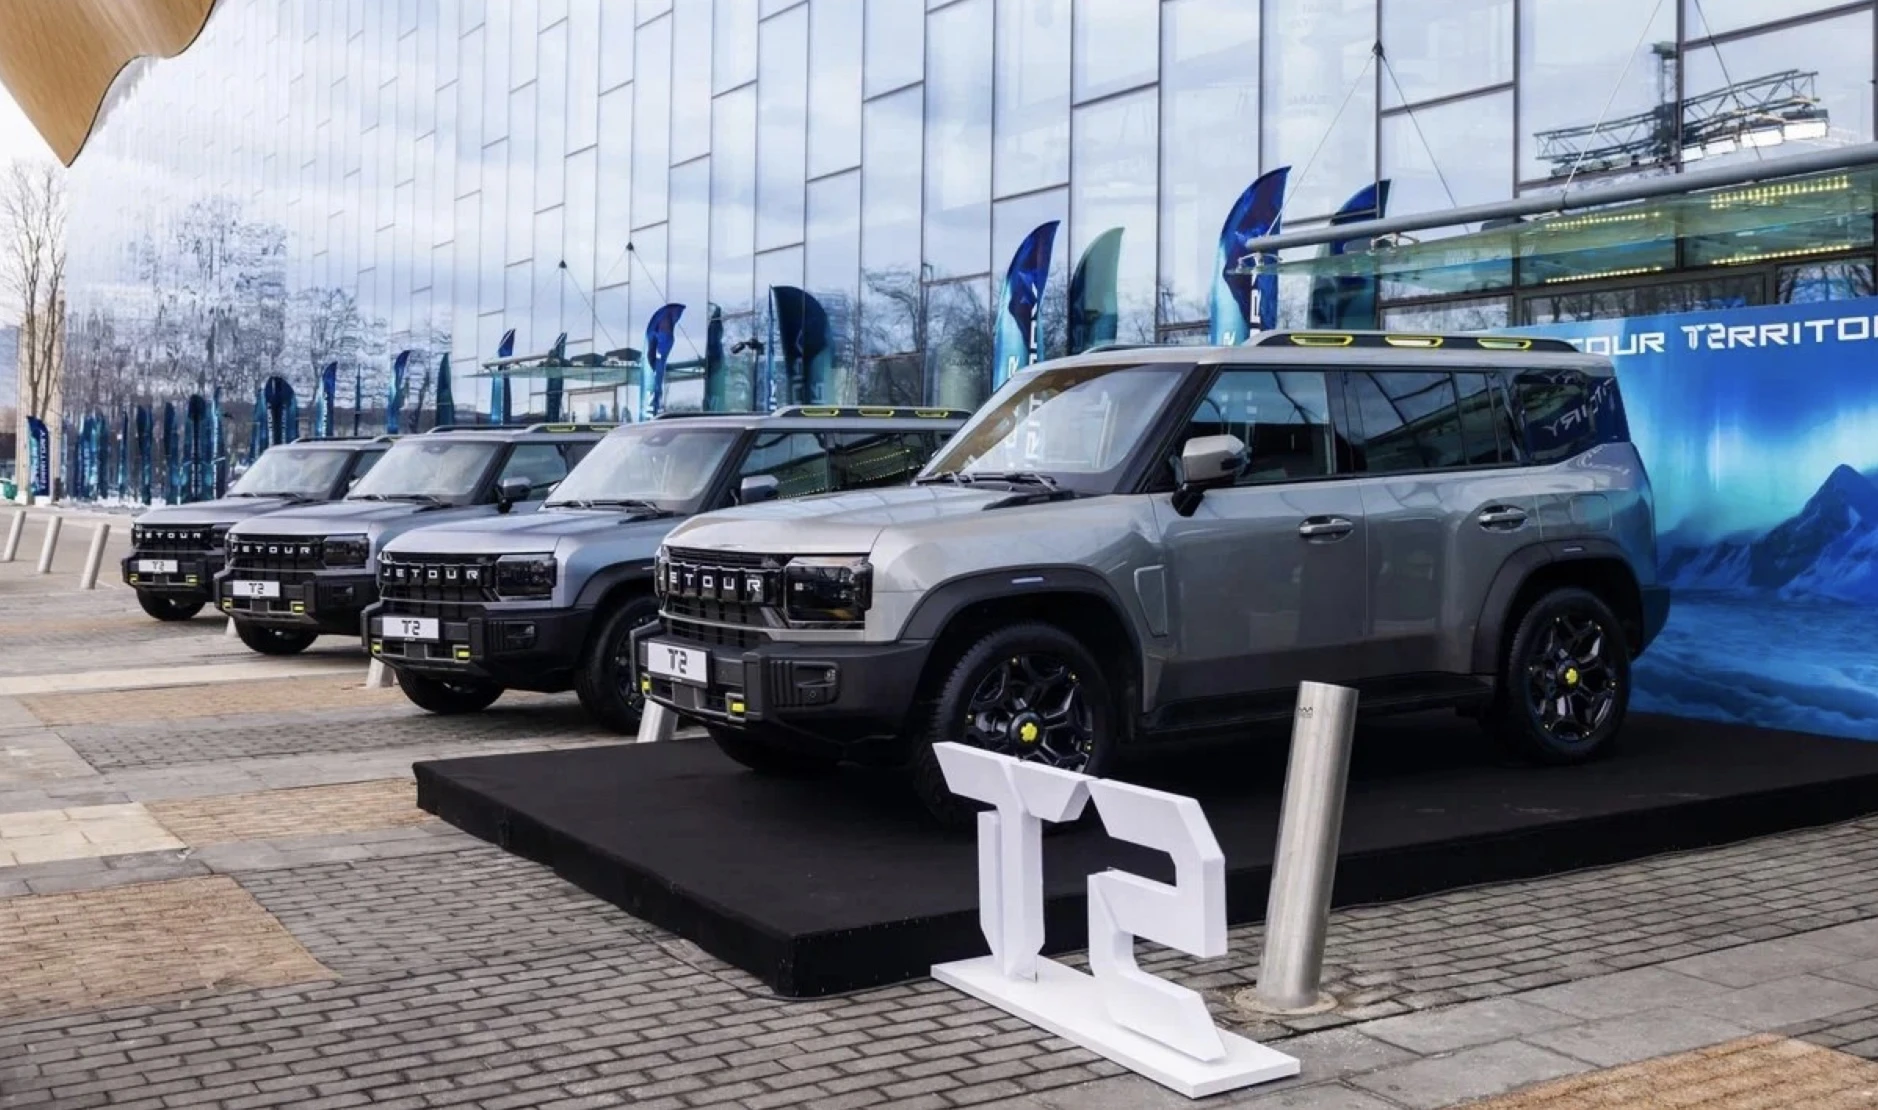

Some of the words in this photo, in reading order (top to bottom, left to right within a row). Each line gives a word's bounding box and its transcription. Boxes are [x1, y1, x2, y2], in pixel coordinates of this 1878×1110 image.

[1680, 315, 1878, 351] T2RRITO
[231, 545, 311, 554] JETOUR
[152, 560, 165, 572] T2
[382, 568, 479, 580] JETOUR
[248, 582, 265, 596] T2
[401, 619, 421, 636] T2
[667, 647, 689, 675] T2
[932, 740, 1228, 1062] T2
